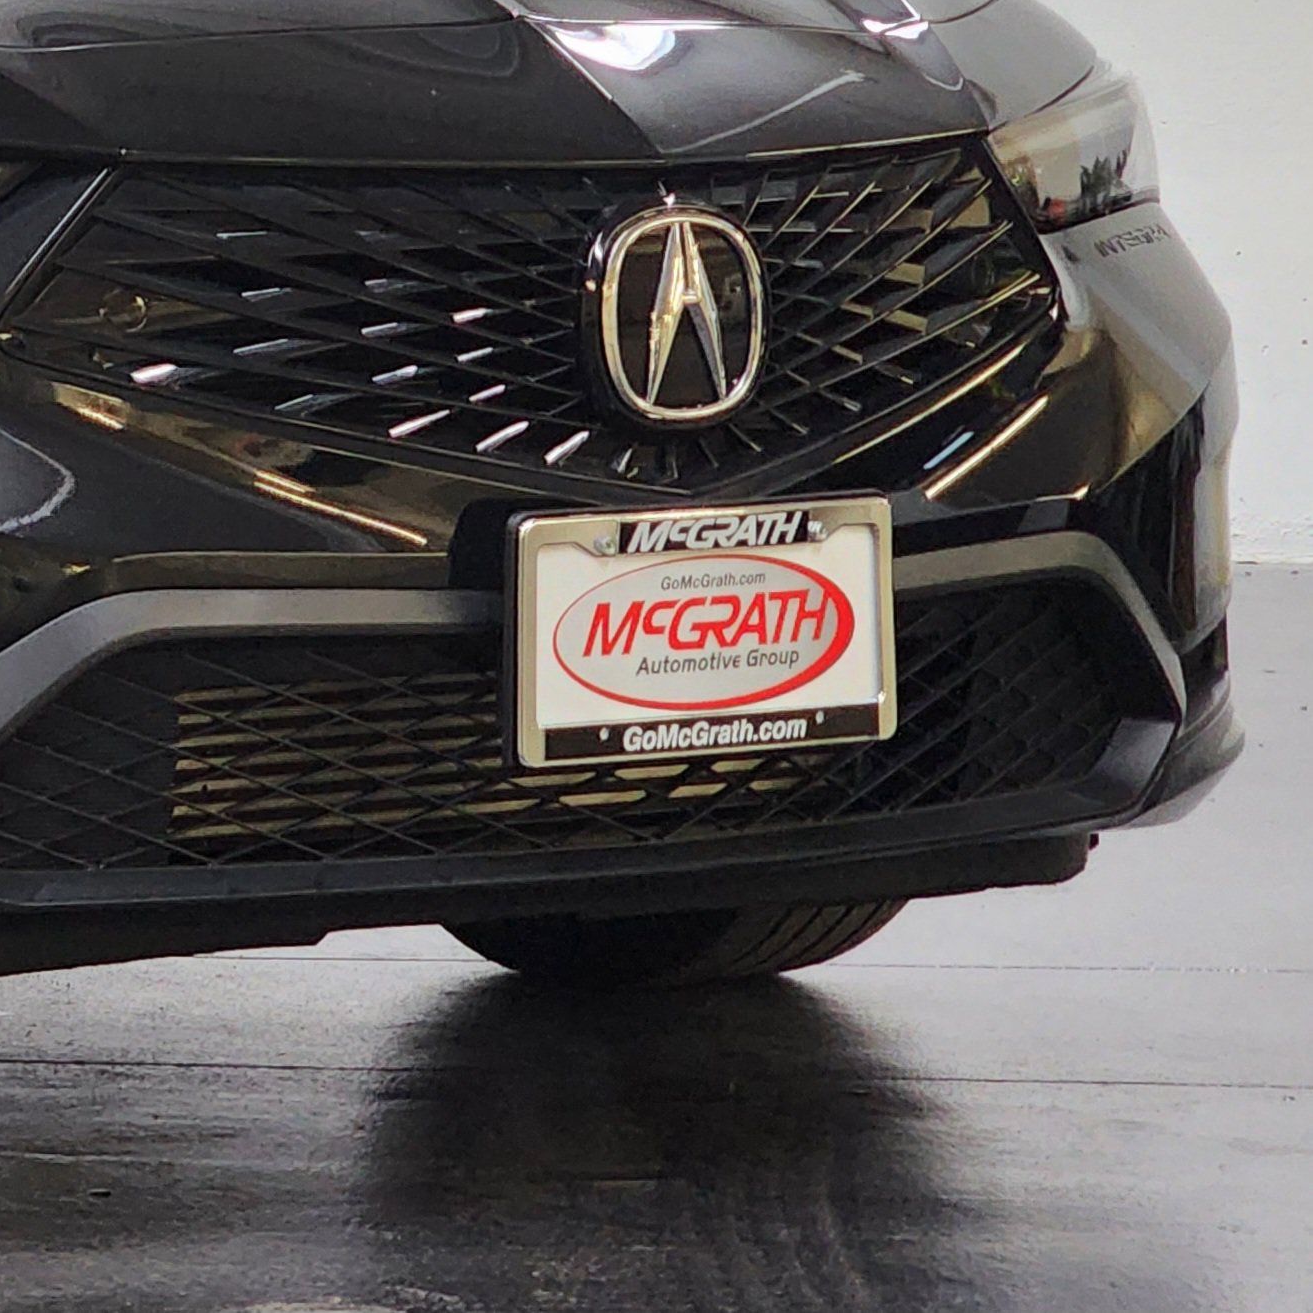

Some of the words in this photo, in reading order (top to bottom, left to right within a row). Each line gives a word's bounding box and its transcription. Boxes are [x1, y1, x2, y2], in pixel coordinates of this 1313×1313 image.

[660, 572, 767, 592] GoMcGrath.com
[636, 652, 742, 676] Automotive
[746, 648, 801, 673] Group
[623, 717, 808, 753] GoMcGrath.com
